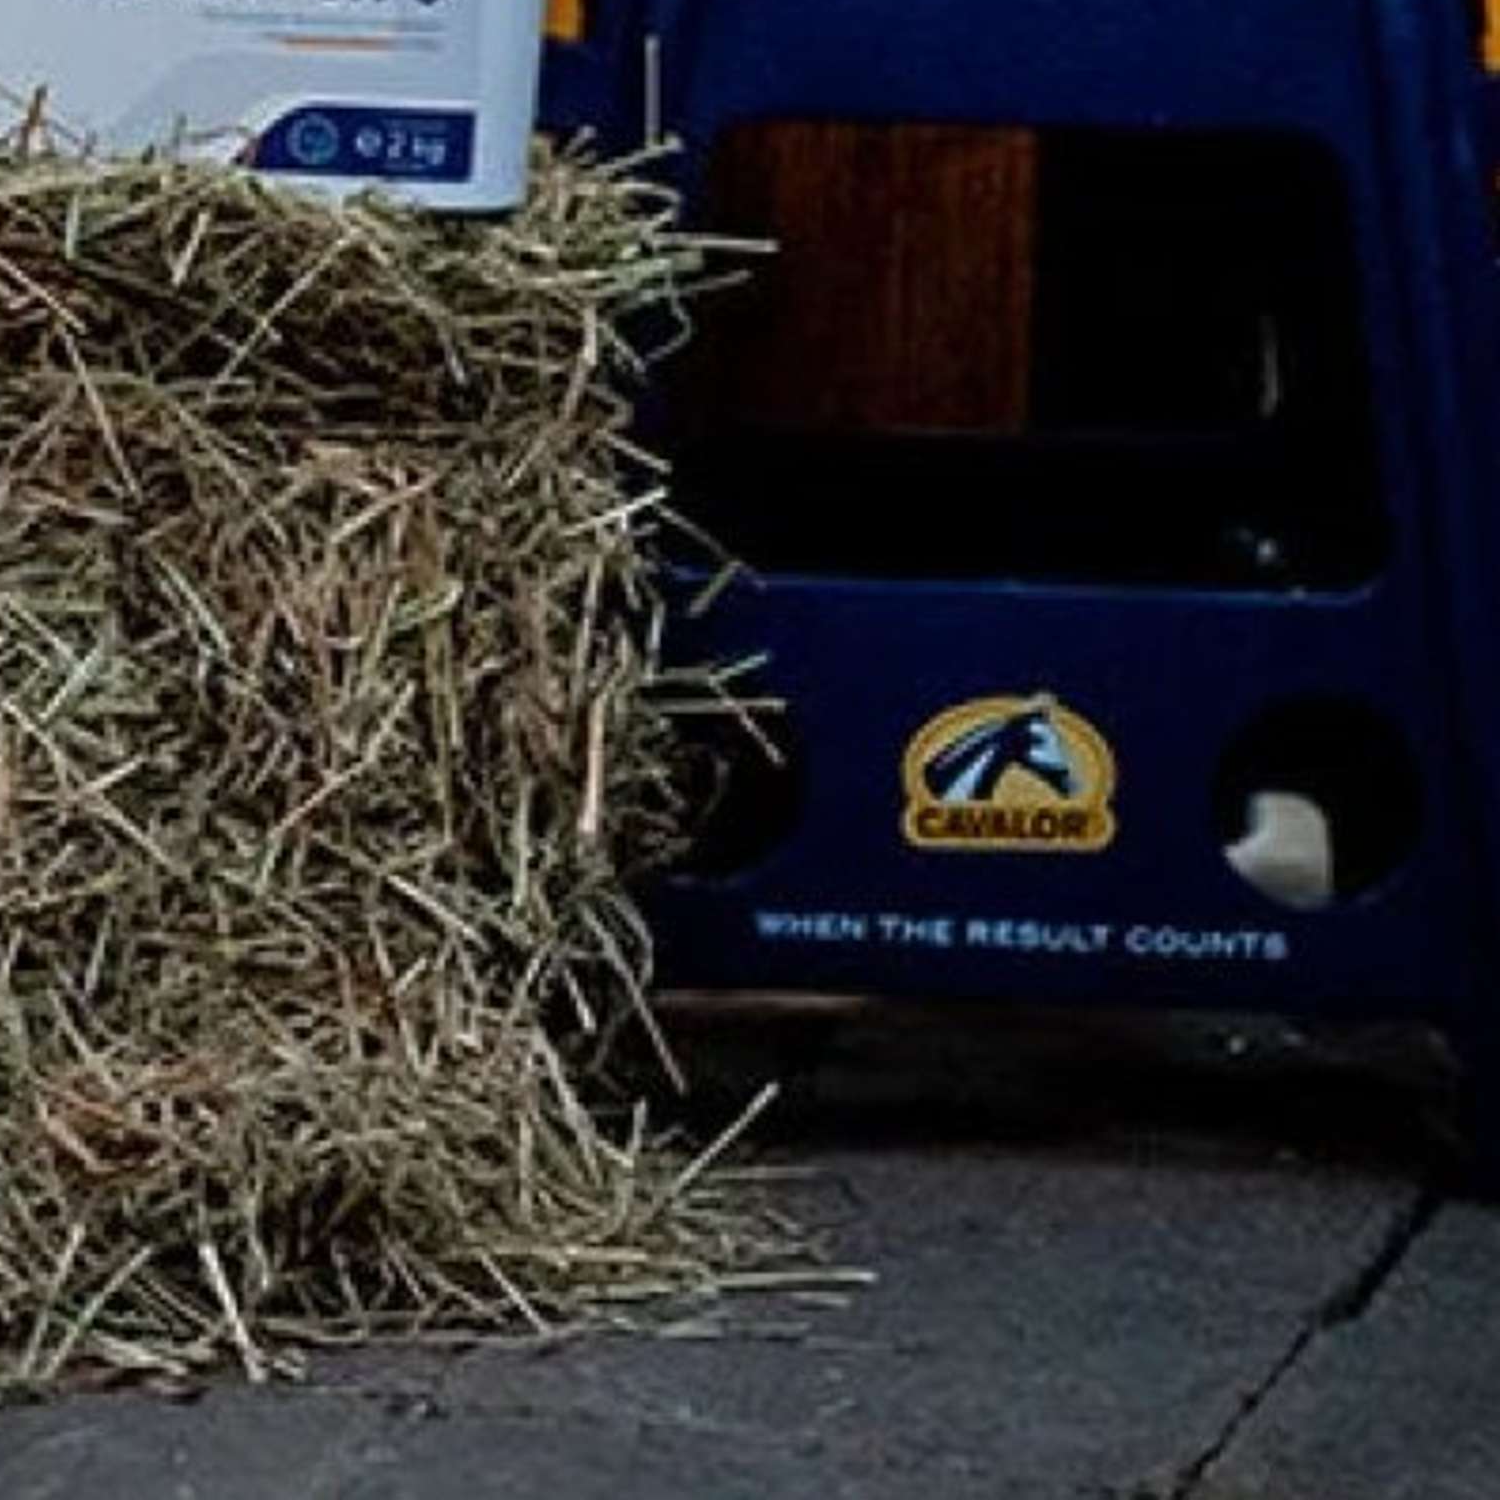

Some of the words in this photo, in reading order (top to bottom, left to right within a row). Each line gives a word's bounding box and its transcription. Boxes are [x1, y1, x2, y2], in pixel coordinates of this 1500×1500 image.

[917, 807, 1089, 839] CAVALOR
[755, 910, 866, 941] WHEN
[879, 913, 957, 948] THE
[965, 919, 1113, 953] RESULT
[1124, 925, 1288, 961] COUNTS
